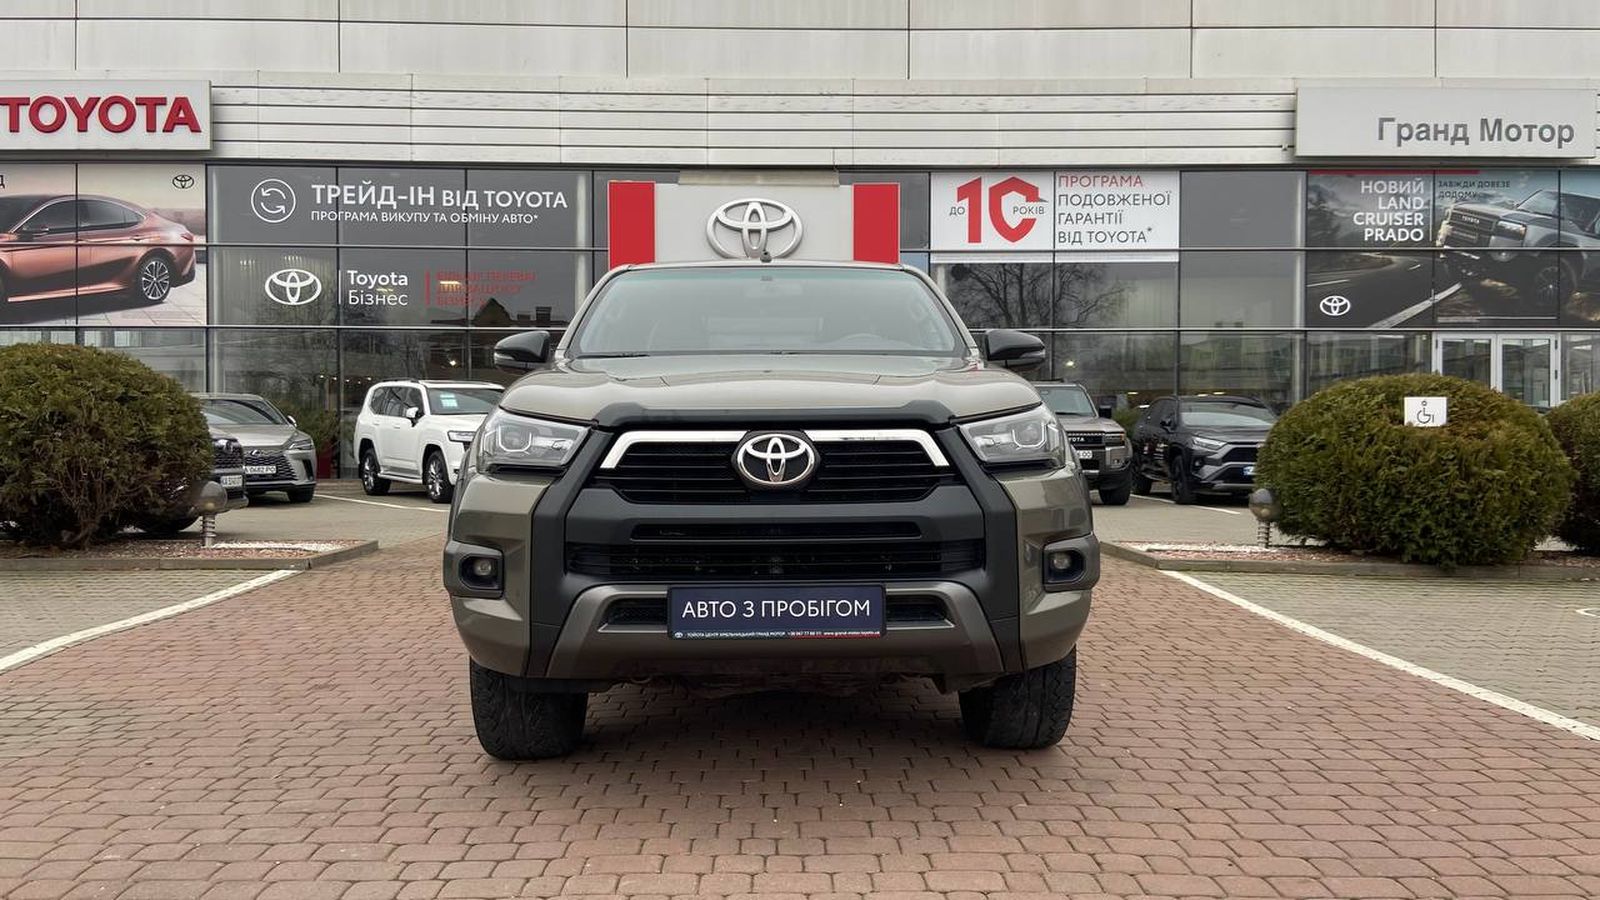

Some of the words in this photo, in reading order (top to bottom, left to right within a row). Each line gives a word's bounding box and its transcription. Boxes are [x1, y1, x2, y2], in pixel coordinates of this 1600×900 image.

[0, 95, 202, 133] TOYOTA
[1377, 117, 1470, 147] Гранд
[1480, 118, 1575, 149] Мотор
[1058, 175, 1144, 188] ПРОГРАМА
[1360, 177, 1425, 195] НОВИЙ
[1438, 181, 1476, 189] ЗАВЖДИ
[1478, 181, 1511, 190] ДОВЕЗЕ
[311, 179, 435, 209] ТРЕЙД-ІН
[442, 189, 479, 210] ВІД
[484, 190, 568, 208] TOYOTA
[1058, 190, 1172, 207] ПОДОВЖЕНОЇ
[949, 205, 967, 217] ДО
[956, 176, 1040, 244] 10
[1012, 205, 1045, 216] РОКІВ
[1378, 197, 1425, 210] LAND
[310, 210, 378, 222] ПРОГРАМА
[381, 212, 430, 223] ВИКУПУ
[433, 212, 449, 223] ТА
[450, 213, 500, 225] ОБМІНУ
[1058, 210, 1124, 225] ГАРАНТІЇ
[1353, 212, 1425, 226] CRUISER
[1058, 231, 1082, 246] ВІД
[1364, 228, 1425, 242] PRADO
[347, 270, 409, 289] Toyota
[348, 289, 409, 306] Бізнес
[681, 601, 737, 618] АВТО
[742, 601, 755, 618] З
[761, 599, 871, 618] ПРОБІГОМ
